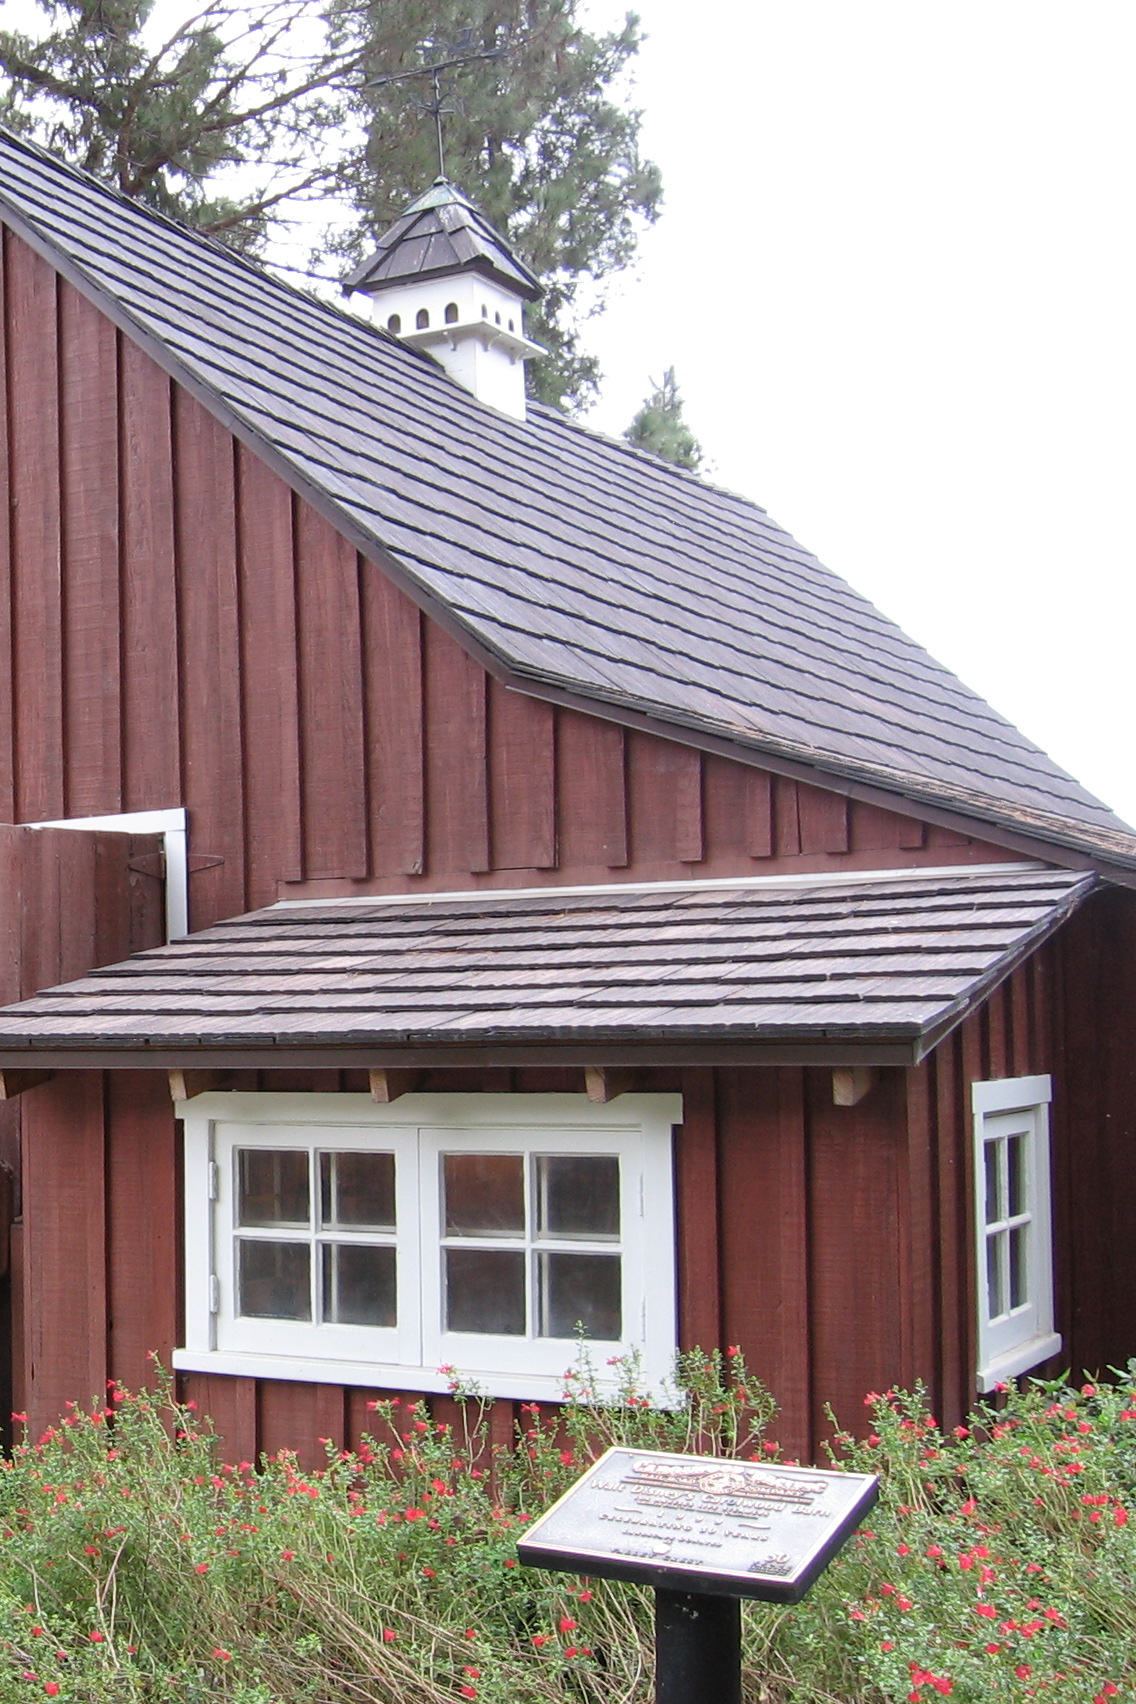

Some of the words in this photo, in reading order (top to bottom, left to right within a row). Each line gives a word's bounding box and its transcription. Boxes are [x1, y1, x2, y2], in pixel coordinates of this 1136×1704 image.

[590, 1478, 624, 1494] Walt
[631, 1485, 695, 1501] Disney's
[701, 1494, 787, 1512] Carolwood
[792, 1505, 831, 1518] Barn
